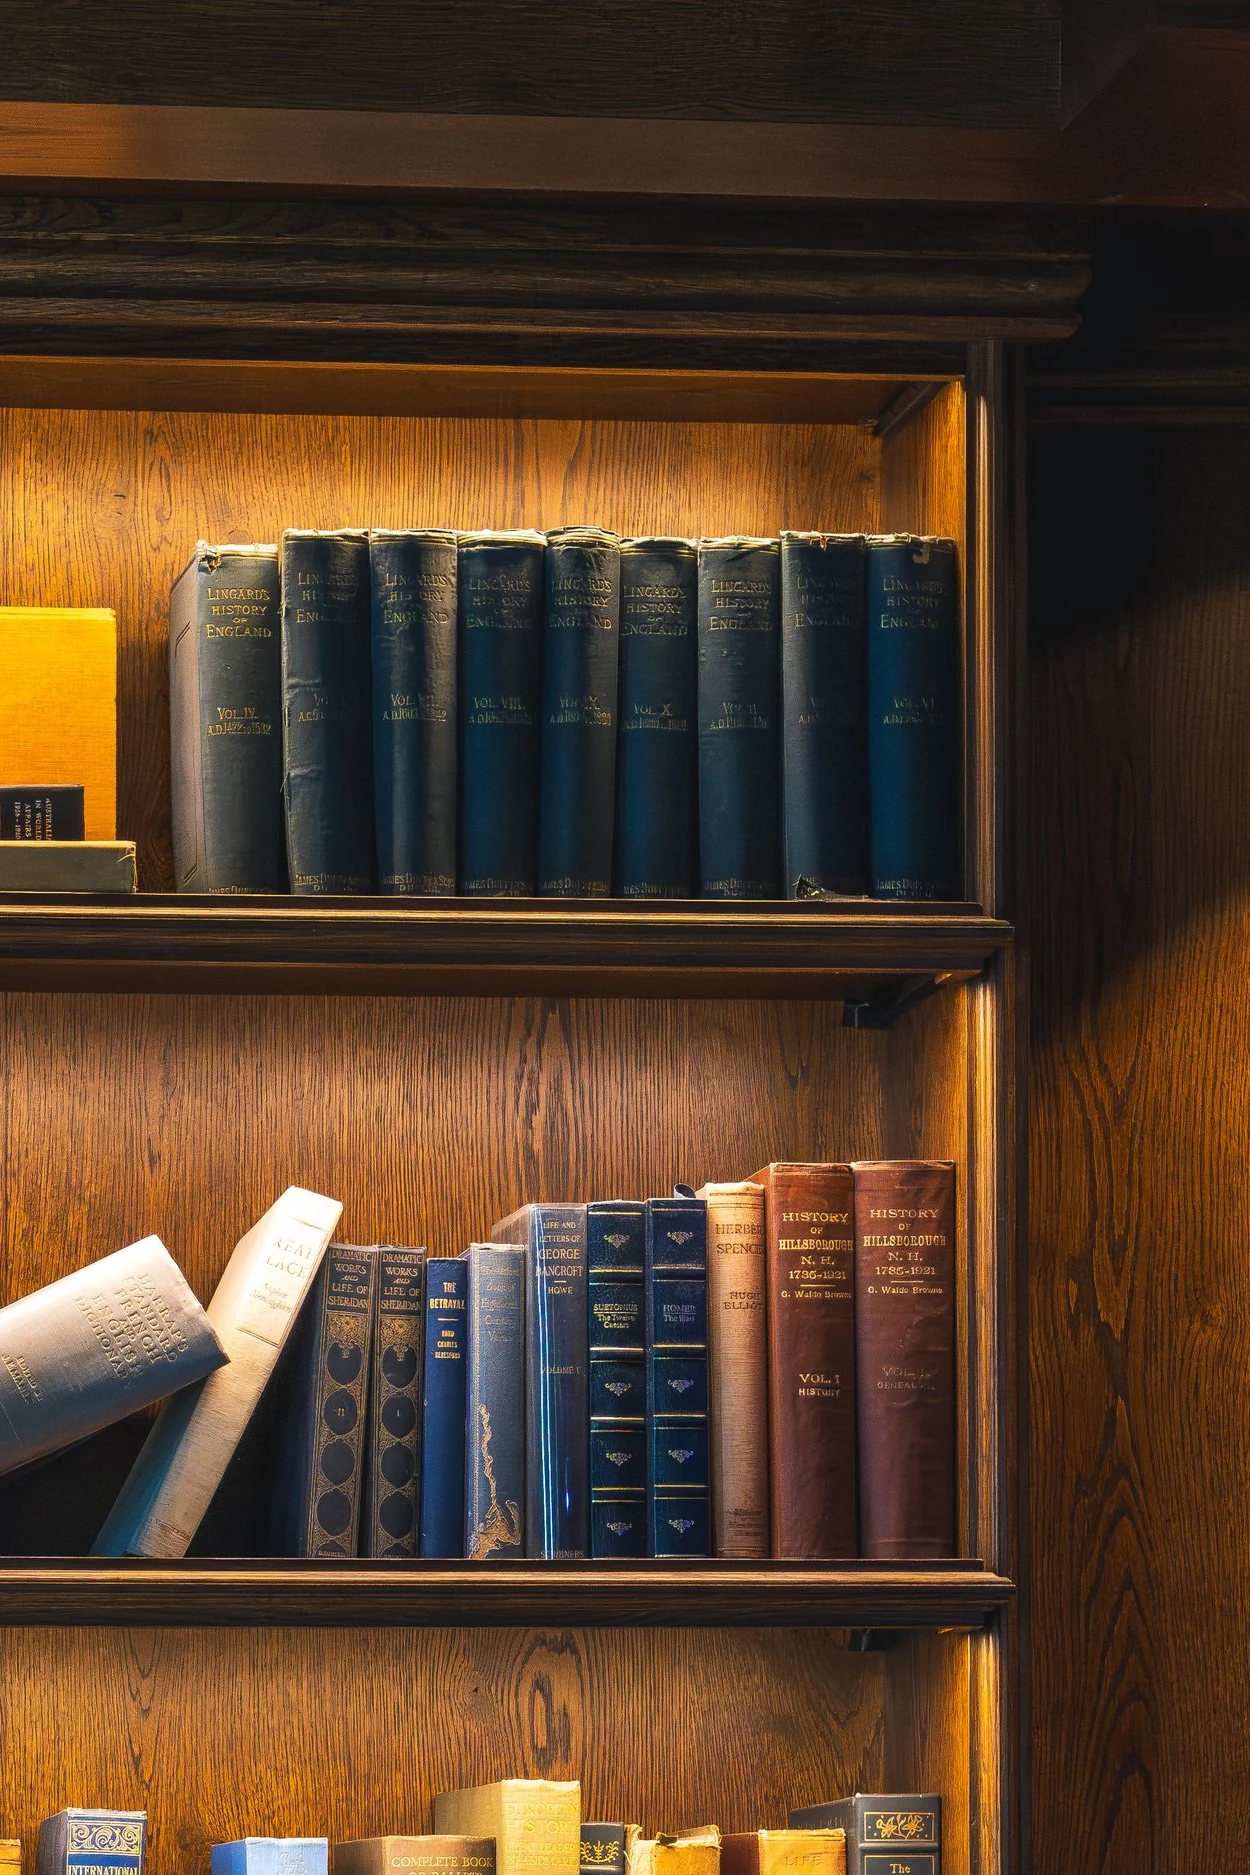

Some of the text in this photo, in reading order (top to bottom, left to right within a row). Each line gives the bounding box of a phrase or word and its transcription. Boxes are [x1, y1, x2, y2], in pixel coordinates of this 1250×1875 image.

[207, 588, 270, 601] LINGARD'S
[211, 605, 267, 616] HISTORY
[206, 624, 271, 638] ENGLAND
[782, 1213, 849, 1222] HISTORY
[870, 1209, 939, 1219] HISTORY
[539, 1235, 568, 1243] LETTERS
[864, 1235, 946, 1247] HILLSBOROUGH
[273, 1236, 314, 1260] REAL
[779, 1240, 853, 1250] HILLSBOROUGH
[331, 1252, 372, 1262] DRAMATIC
[538, 1249, 580, 1259] GEORGE
[265, 1253, 308, 1280] LACE
[333, 1264, 367, 1274] WORKS
[536, 1265, 583, 1277] BANCROFT
[332, 1283, 369, 1294] LIFE OF
[443, 1282, 456, 1293] THE
[881, 1286, 909, 1294] Waldo
[328, 1296, 370, 1309] SHERIDAN
[430, 1298, 464, 1309] BETRAYAL
[593, 1303, 637, 1311] SUETONIUS
[139, 1273, 188, 1352] HARRAP'S
[663, 1304, 696, 1314] HOMER
[124, 1276, 177, 1363] STANDARD
[114, 1288, 165, 1363] FRENCH
[392, 1856, 493, 1868] COMPLETE BOOK
[890, 1864, 910, 1874] The
